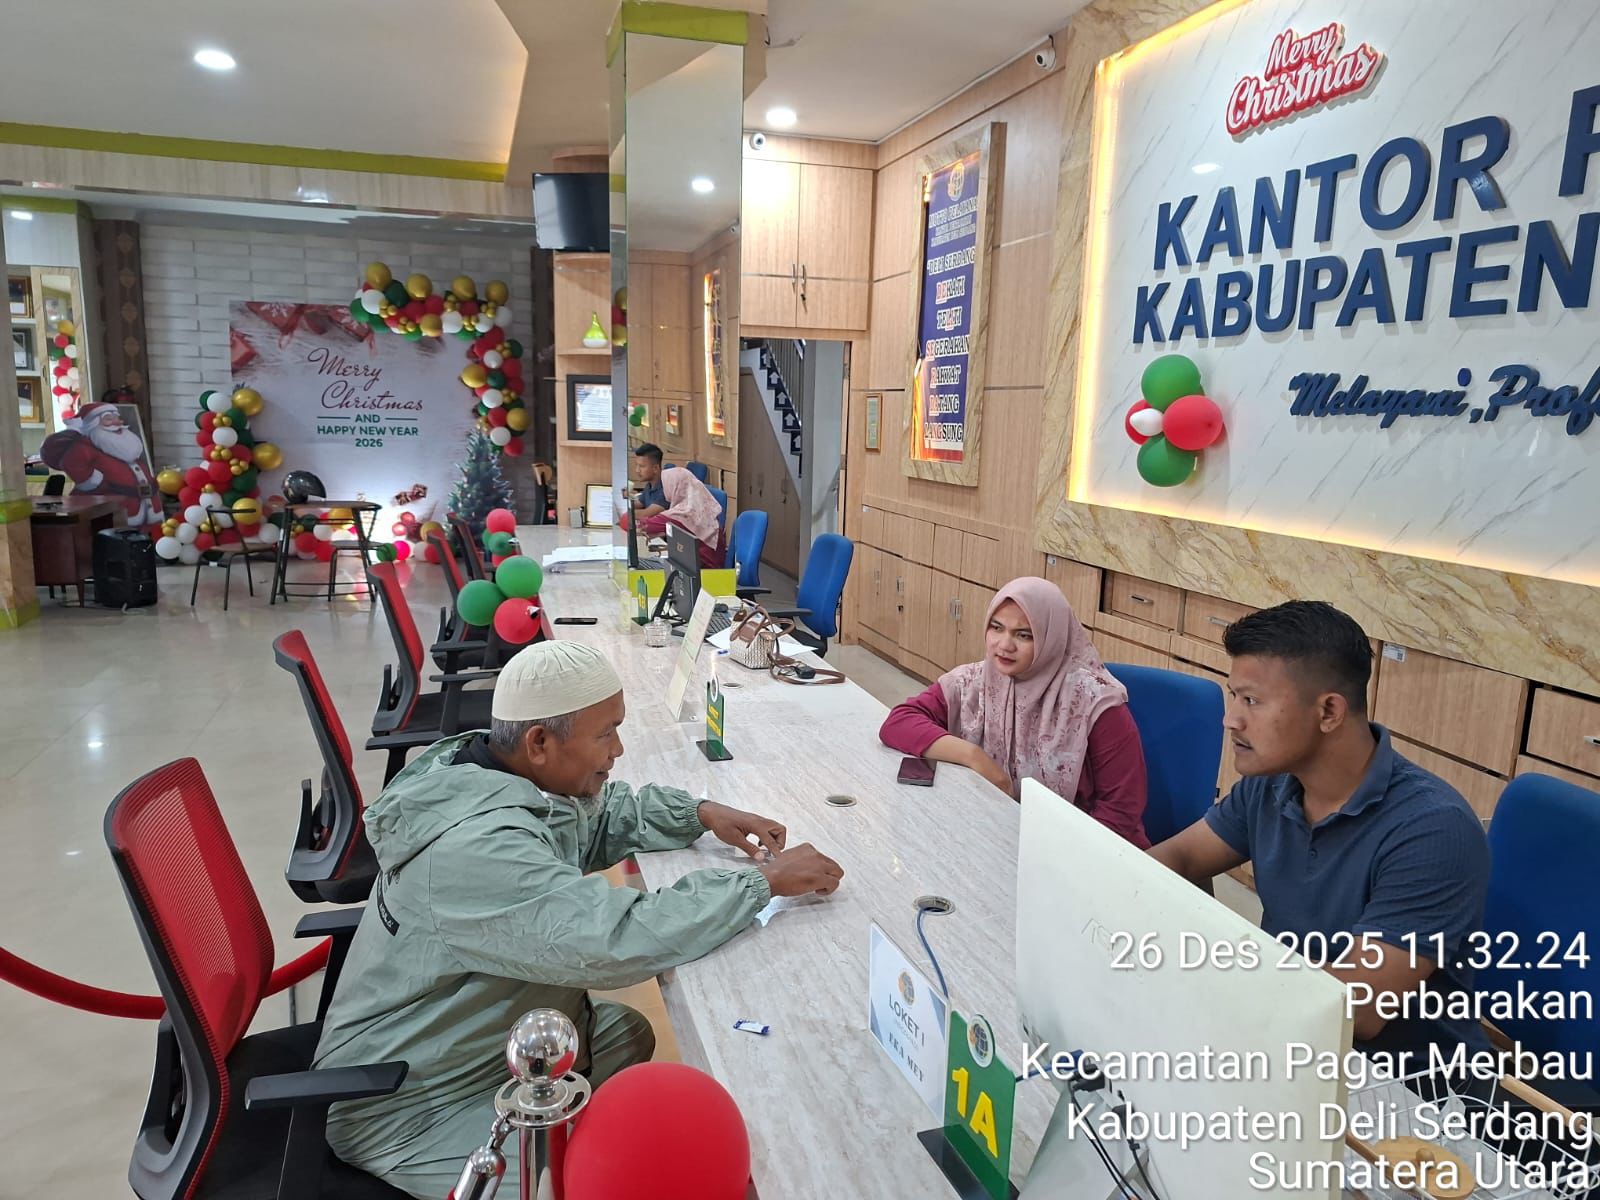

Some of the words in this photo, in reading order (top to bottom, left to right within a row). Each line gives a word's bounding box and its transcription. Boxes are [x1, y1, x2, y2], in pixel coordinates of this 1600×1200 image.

[1266, 23, 1337, 75] Merry
[1227, 45, 1377, 131] Christmas
[1153, 115, 1511, 271] KANTOR
[1132, 212, 1600, 344] KABUPATEN
[307, 347, 382, 391] Merry
[321, 380, 423, 411] Christmas
[355, 414, 381, 423] AND
[1483, 364, 1600, 436] Prof
[317, 425, 356, 435] HAPPY
[360, 426, 386, 436] NEW
[389, 427, 418, 436] YEAR
[355, 438, 383, 448] 2026
[889, 993, 919, 1038] LOKET
[952, 1066, 998, 1159] 1A
